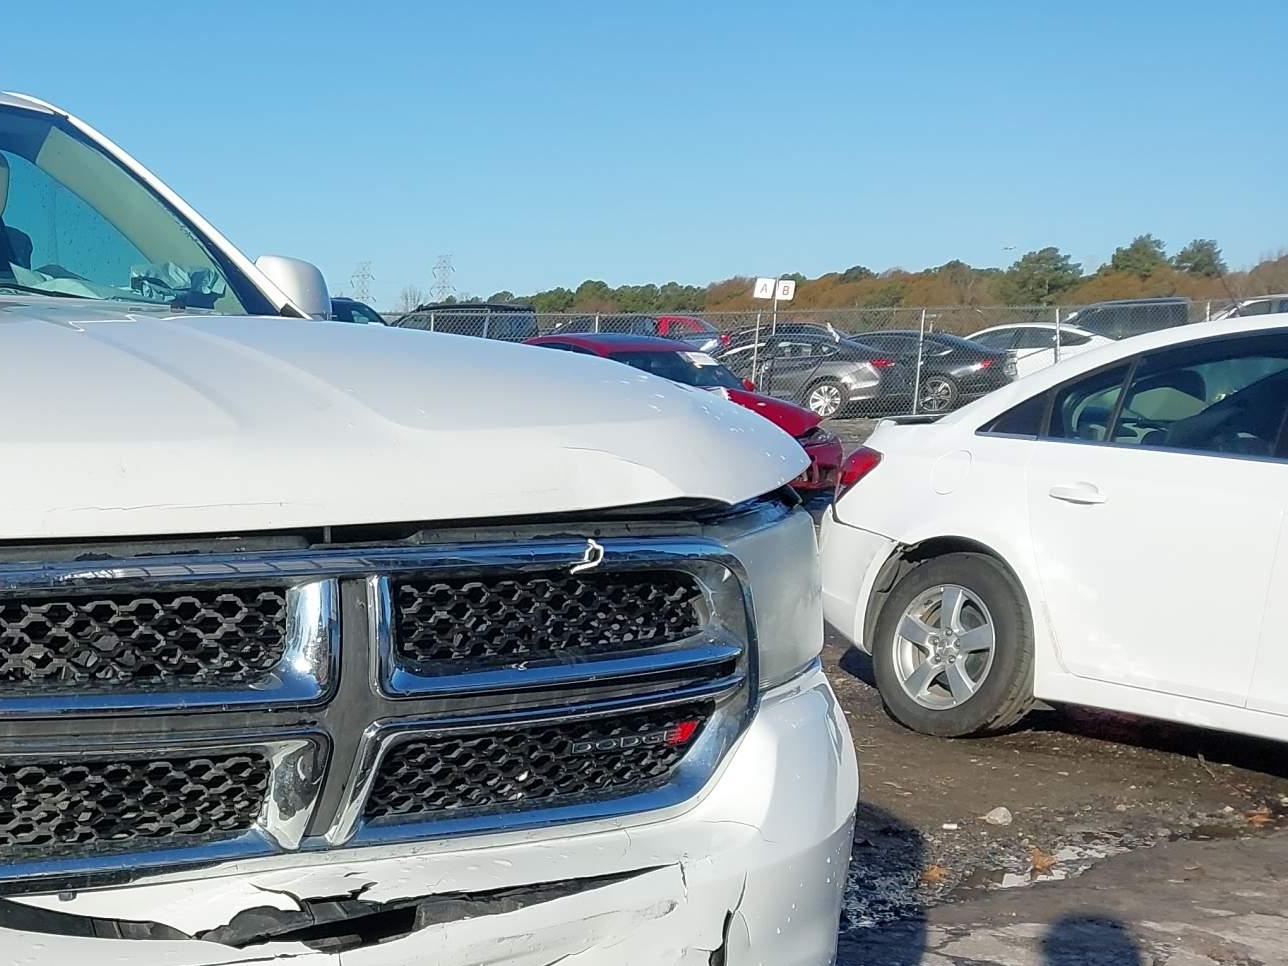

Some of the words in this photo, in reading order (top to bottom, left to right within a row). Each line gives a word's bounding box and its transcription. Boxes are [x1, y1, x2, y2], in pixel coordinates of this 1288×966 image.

[760, 283, 768, 294] A
[782, 285, 791, 296] B
[572, 729, 682, 754] DODGE
